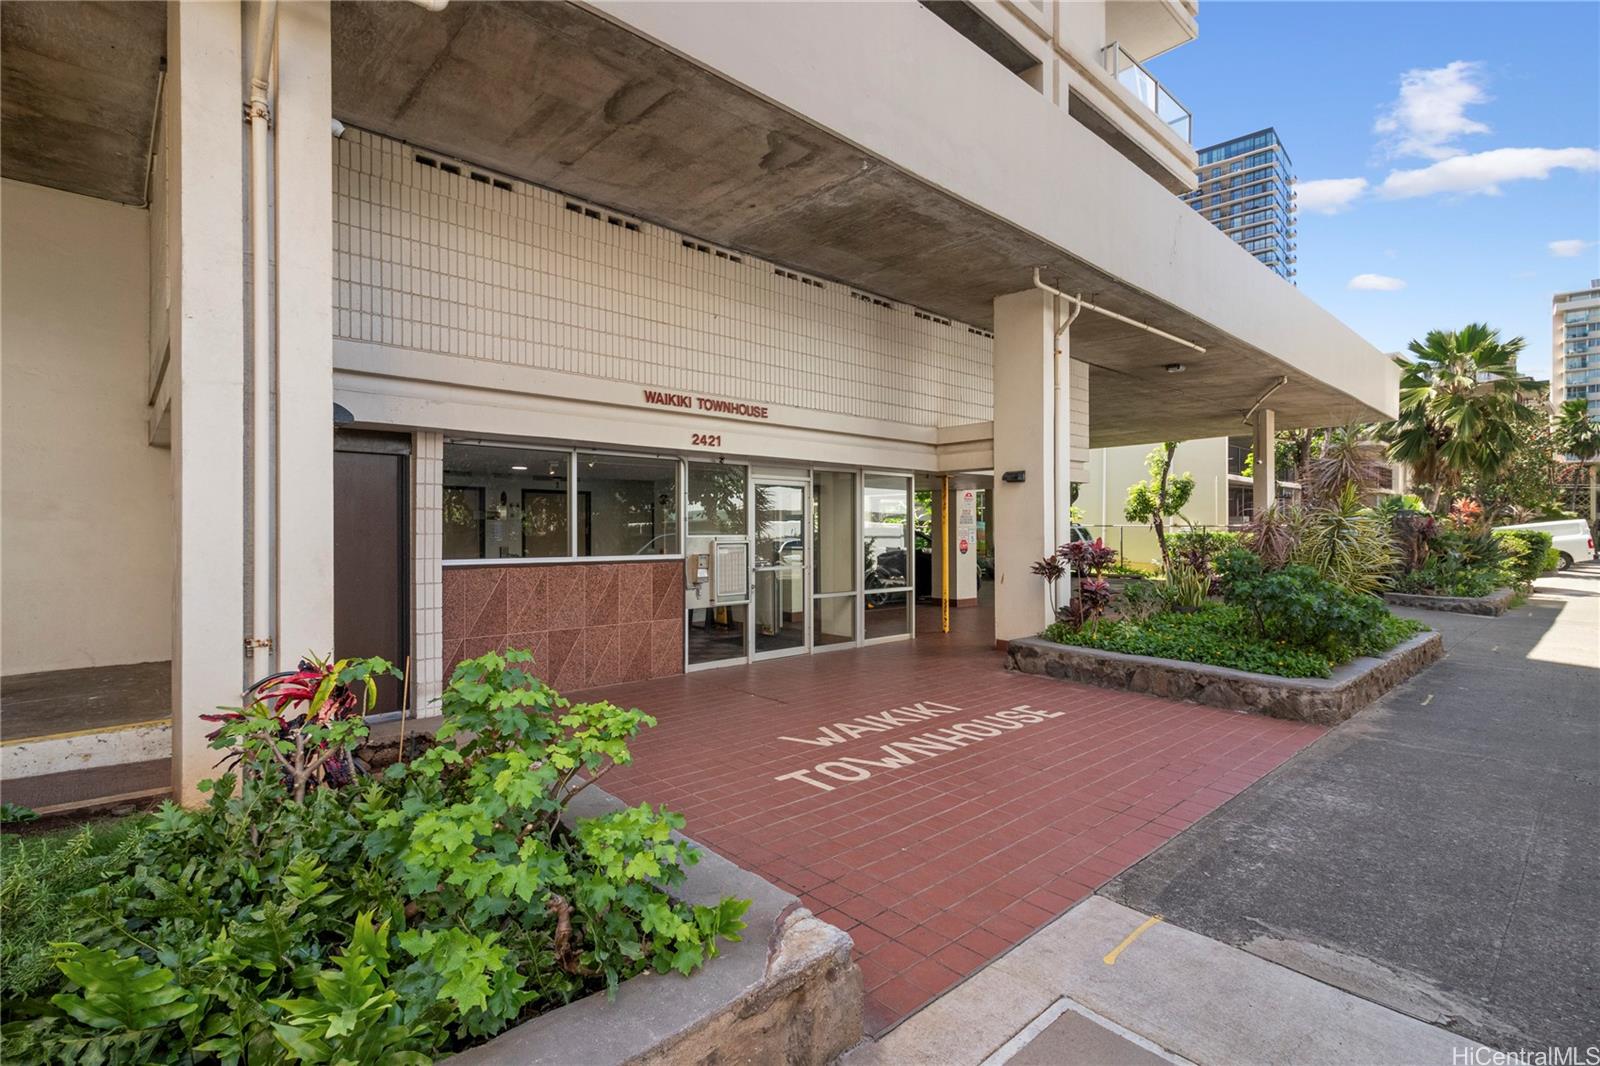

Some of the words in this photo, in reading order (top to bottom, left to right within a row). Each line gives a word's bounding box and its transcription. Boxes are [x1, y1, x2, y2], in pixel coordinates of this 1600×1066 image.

[643, 390, 692, 408] WAIKIKI
[696, 398, 768, 418] TOWNHOUSE
[691, 433, 721, 447] 2421
[777, 701, 963, 747] WAIKIKI
[774, 705, 1066, 791] TOWNHOUSE
